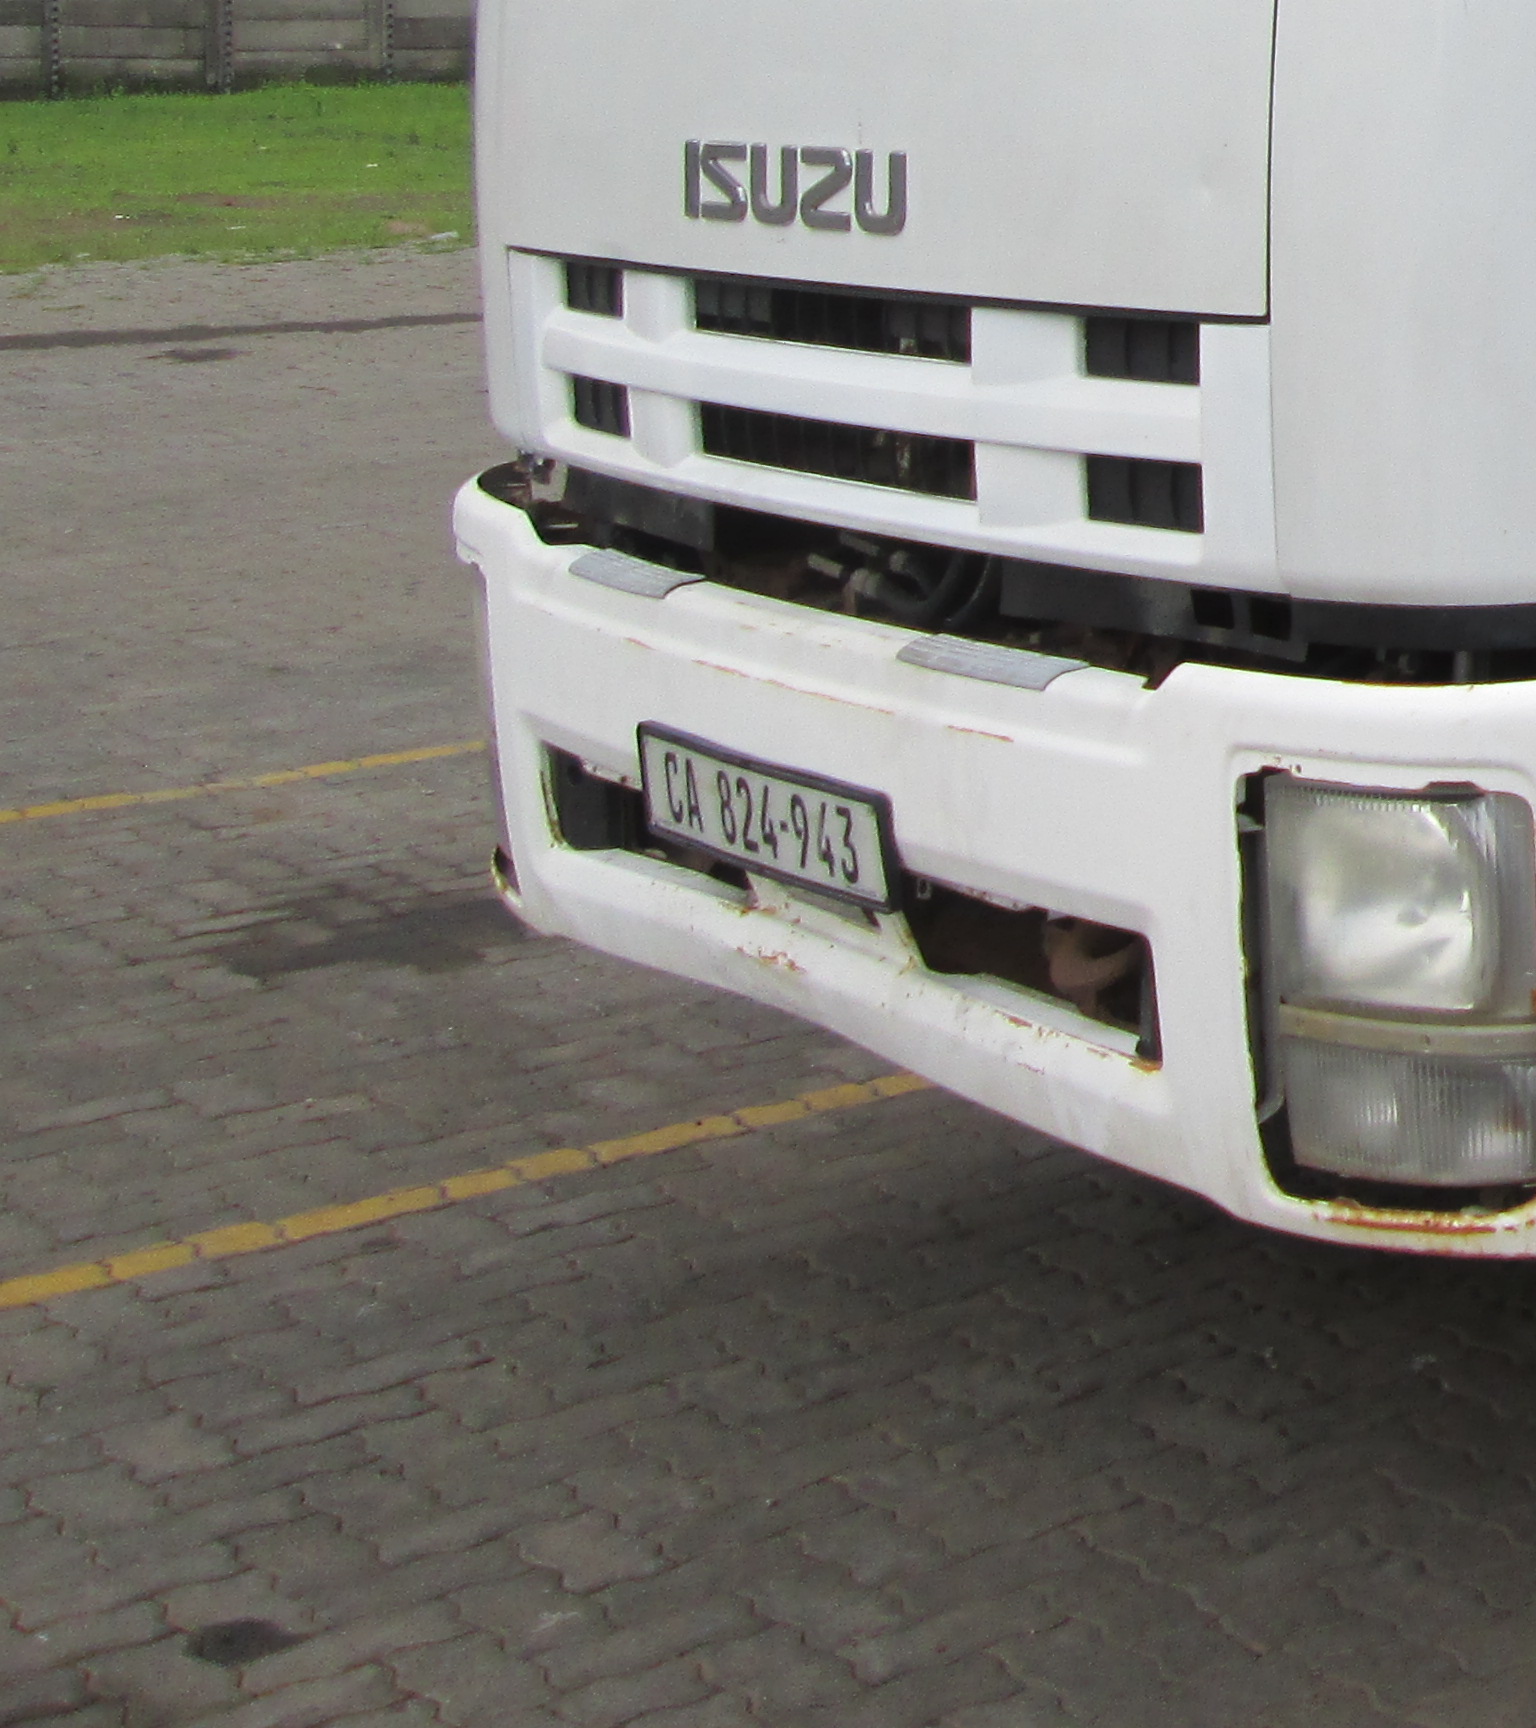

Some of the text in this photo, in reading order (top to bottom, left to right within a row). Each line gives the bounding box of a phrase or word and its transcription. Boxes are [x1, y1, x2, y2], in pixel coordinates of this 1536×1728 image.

[683, 138, 908, 237] ISUZU
[664, 750, 860, 885] CA 824-943
